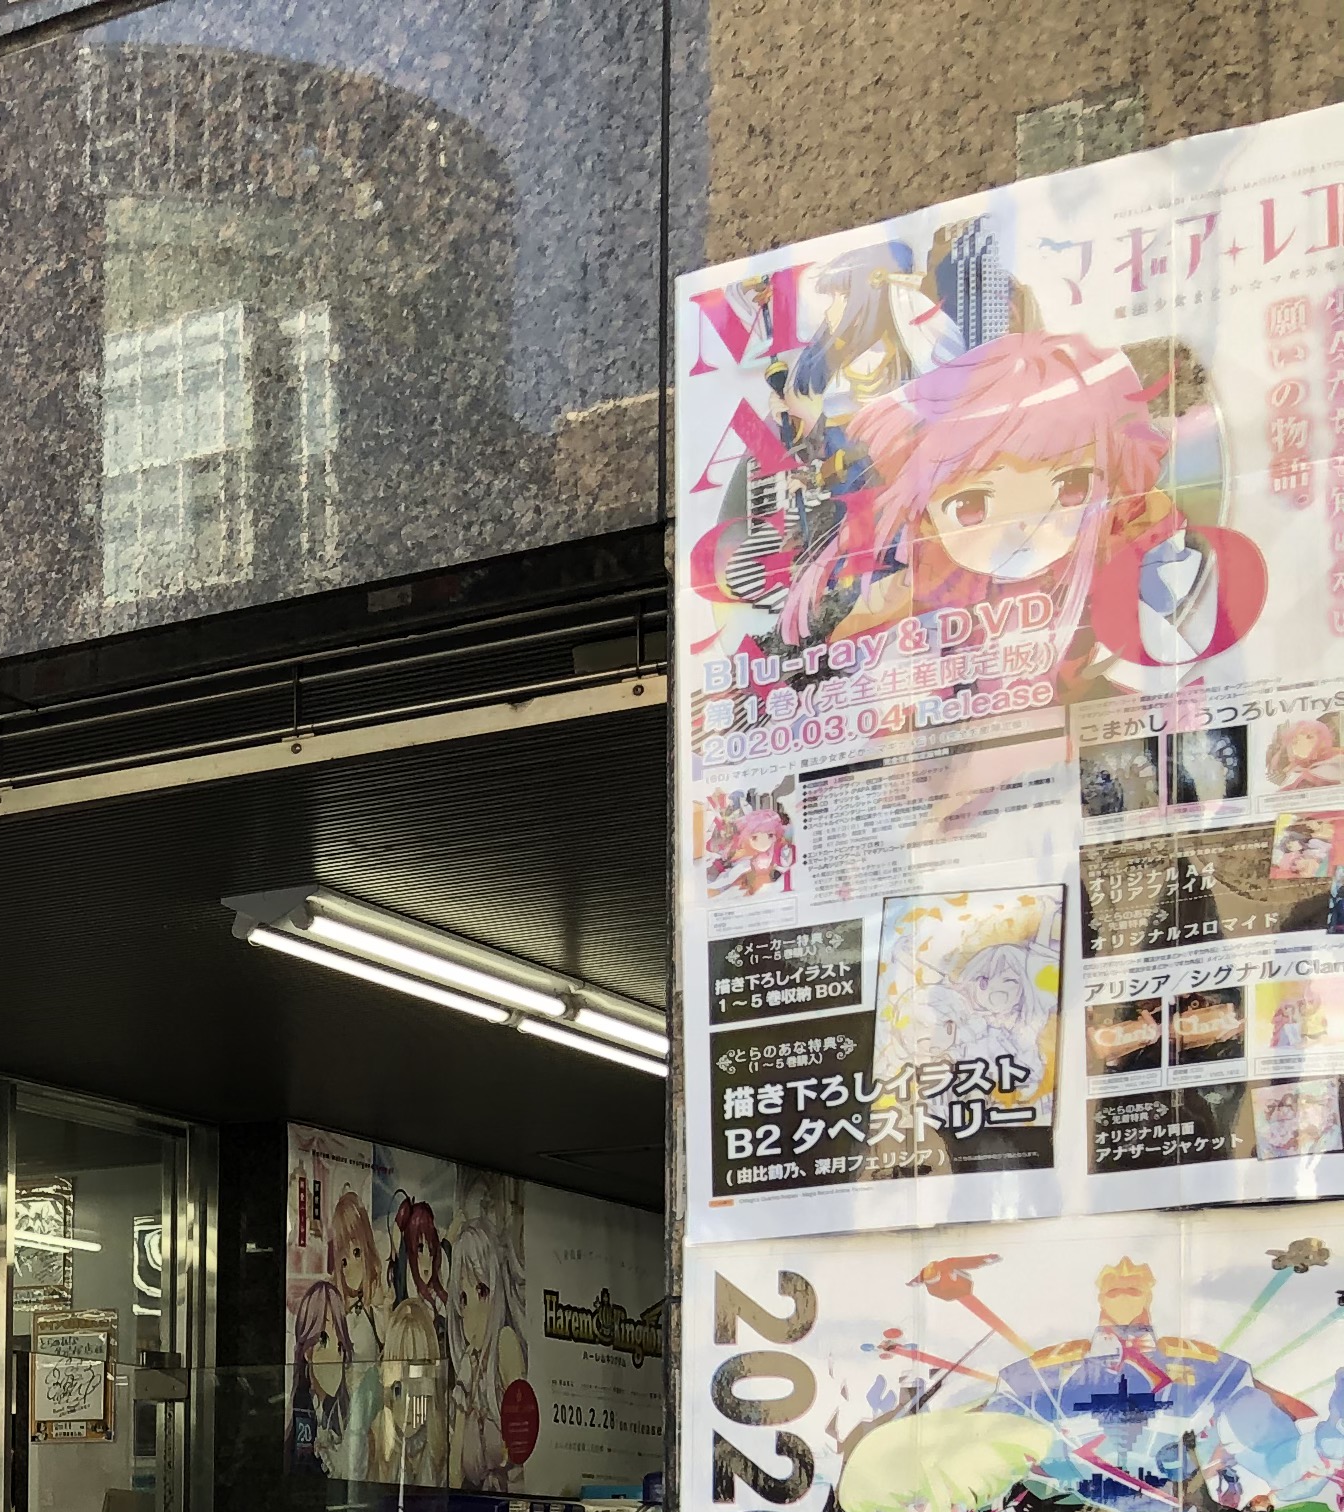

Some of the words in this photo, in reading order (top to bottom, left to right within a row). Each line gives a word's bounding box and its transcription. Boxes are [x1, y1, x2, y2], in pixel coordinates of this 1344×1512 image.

[703, 631, 887, 693] Blu-ray
[936, 591, 1055, 645] DVD
[703, 707, 906, 767] 2020.03.04
[915, 681, 1055, 728] Release
[1089, 874, 1217, 907] クリアファイル
[743, 932, 823, 956] メーカー特典
[1090, 912, 1279, 950] オリジナルブロマイド
[714, 962, 852, 996] 描き下ろしイラスト
[814, 979, 855, 999] BOX
[733, 1035, 838, 1063] とらのあな特典
[722, 1054, 1032, 1122] 描き下ろしイラスト
[724, 1124, 783, 1161] B2
[790, 1098, 1038, 1157] タペストリー
[1094, 1121, 1196, 1145] オリジナル両面
[1095, 1133, 1244, 1164] アナザージャケット
[553, 1403, 616, 1430] 2020.2.28
[629, 1419, 663, 1437] release
